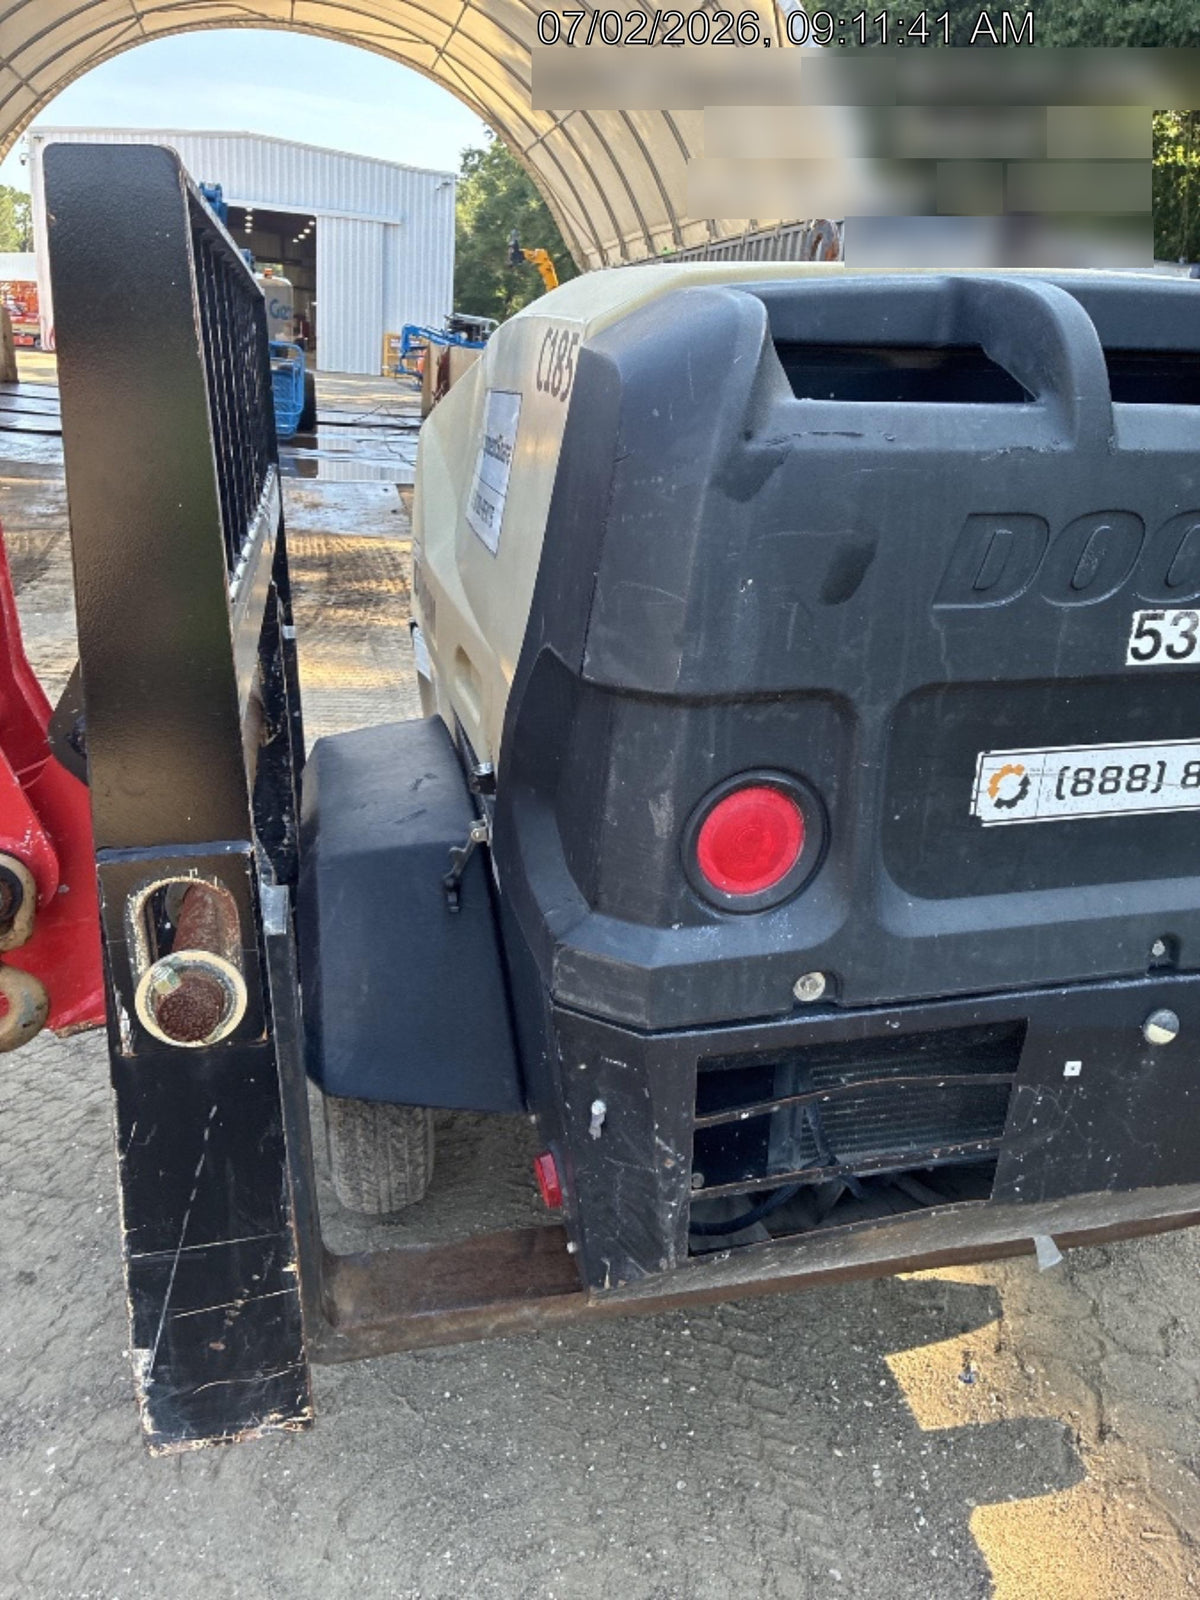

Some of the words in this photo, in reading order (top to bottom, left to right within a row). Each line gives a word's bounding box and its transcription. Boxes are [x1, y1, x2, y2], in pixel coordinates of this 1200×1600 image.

[537, 327, 580, 402] C185
[1130, 612, 1200, 661] 53
[1055, 760, 1167, 800] (888)
